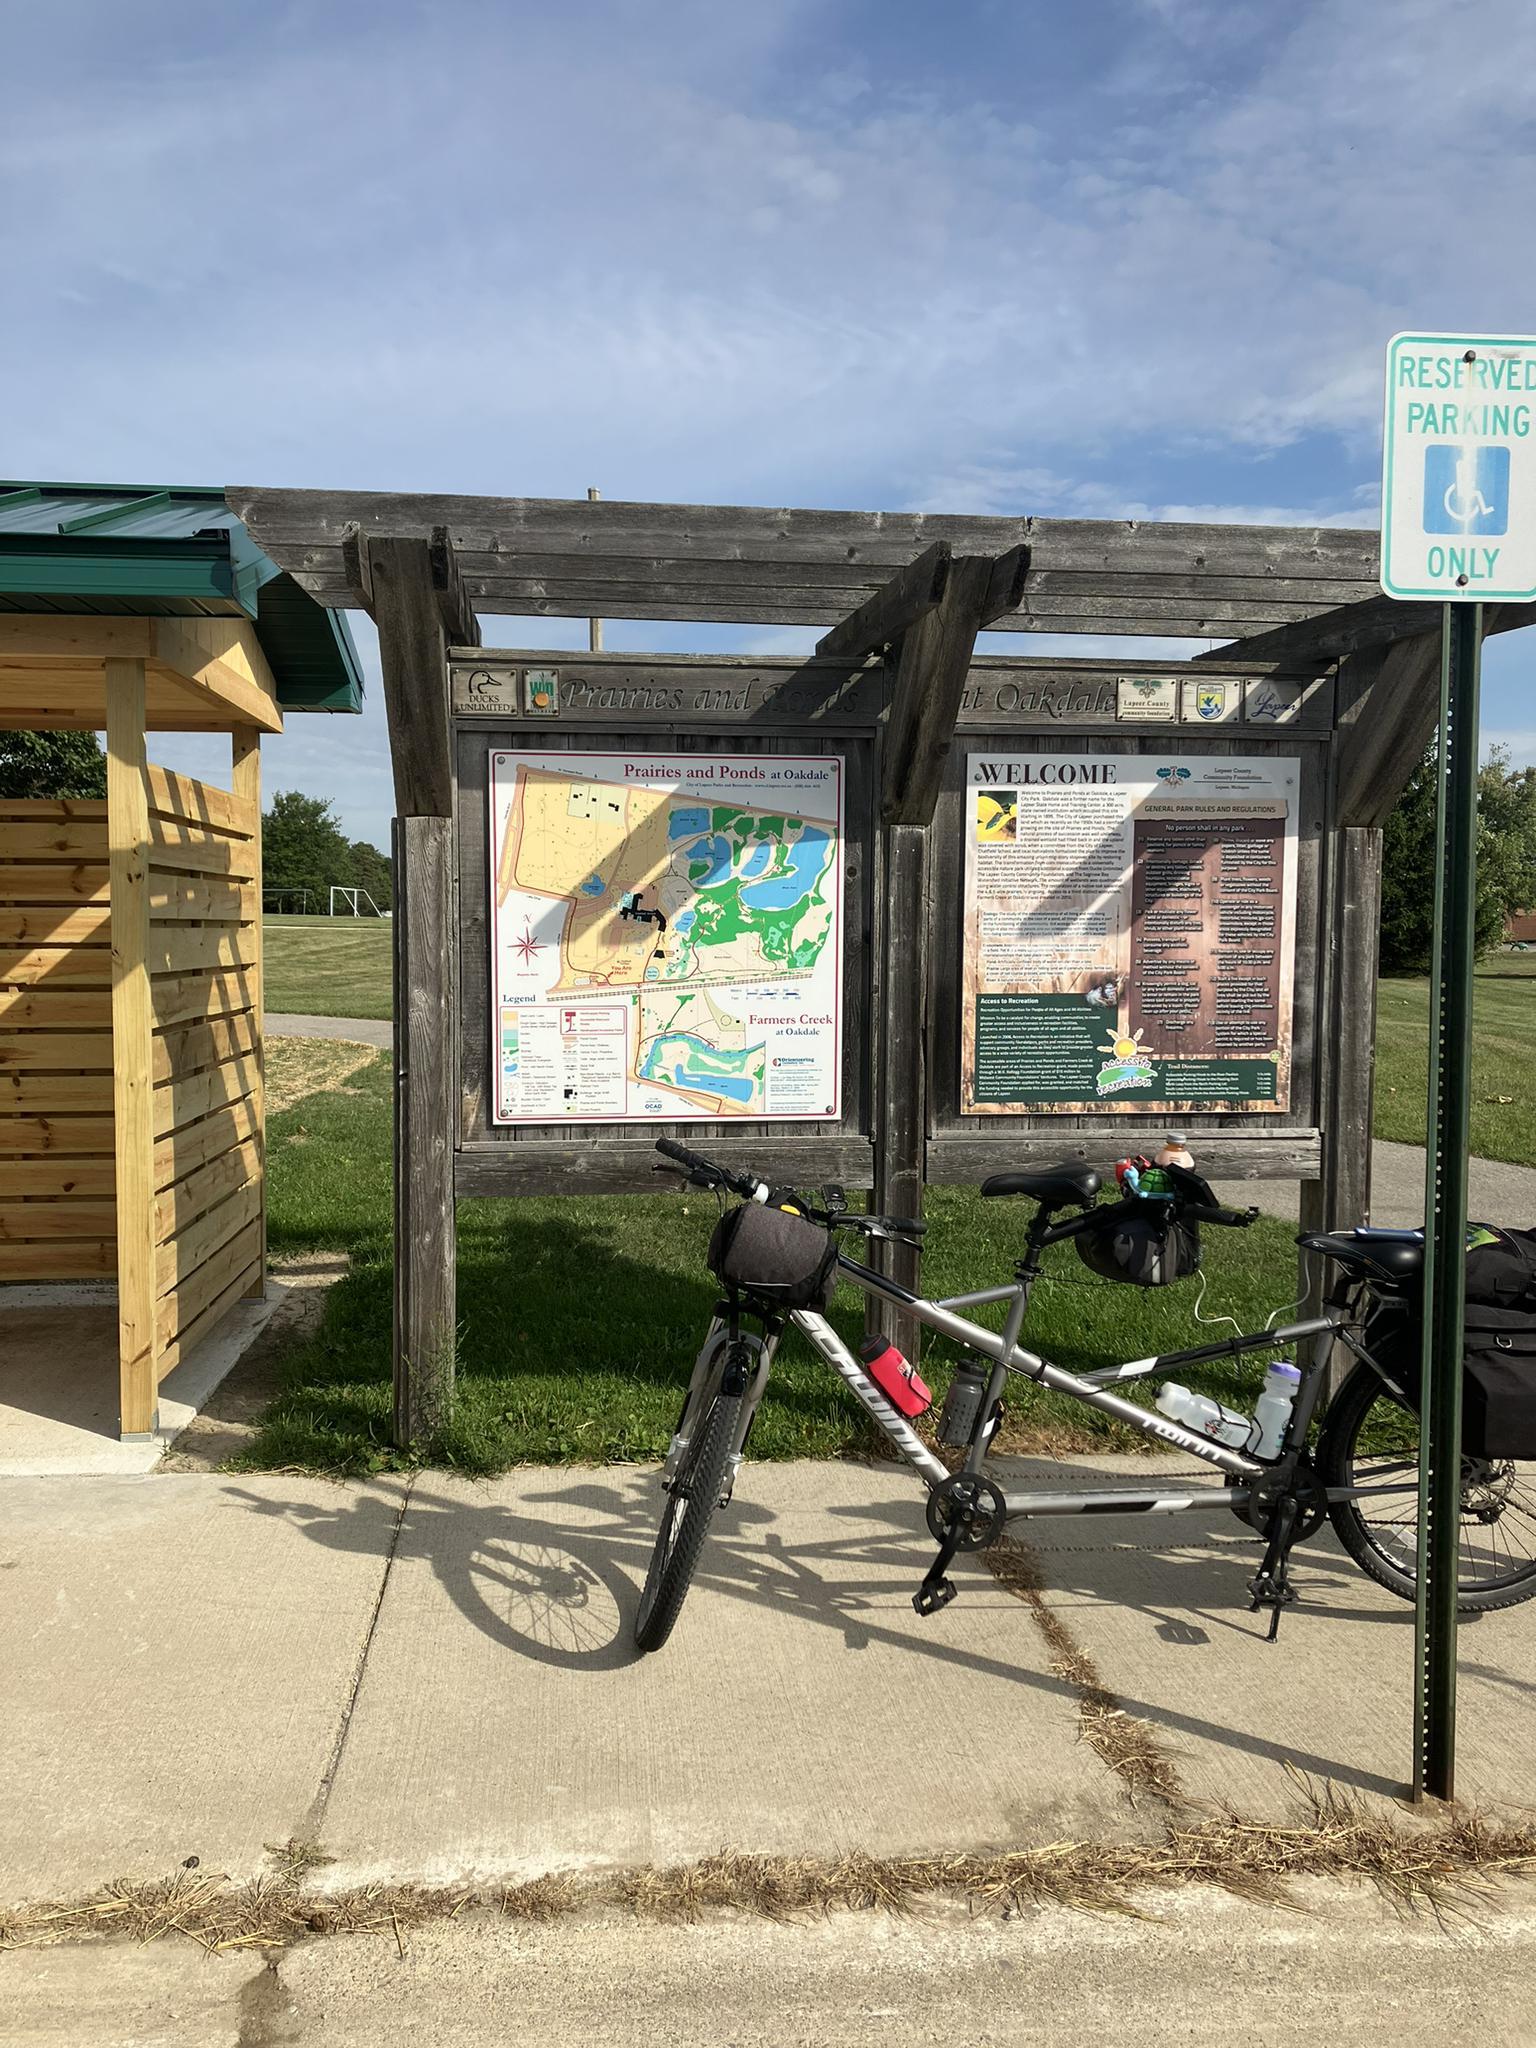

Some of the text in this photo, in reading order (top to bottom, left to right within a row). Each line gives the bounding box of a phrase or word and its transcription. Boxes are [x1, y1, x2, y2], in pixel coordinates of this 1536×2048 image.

[1400, 356, 1536, 390] RESERVED
[1408, 402, 1530, 437] PARKING
[1428, 546, 1500, 578] ONLY
[560, 678, 859, 713] Prairies and Ponds
[994, 680, 1116, 719] Oakdale
[624, 764, 829, 780] Prairies and Ponds at Oakdale
[979, 763, 1116, 784] WELCOME
[503, 994, 536, 1004] Legend
[749, 1014, 833, 1024] Farmers Creek
[786, 1028, 820, 1036] Oakdale
